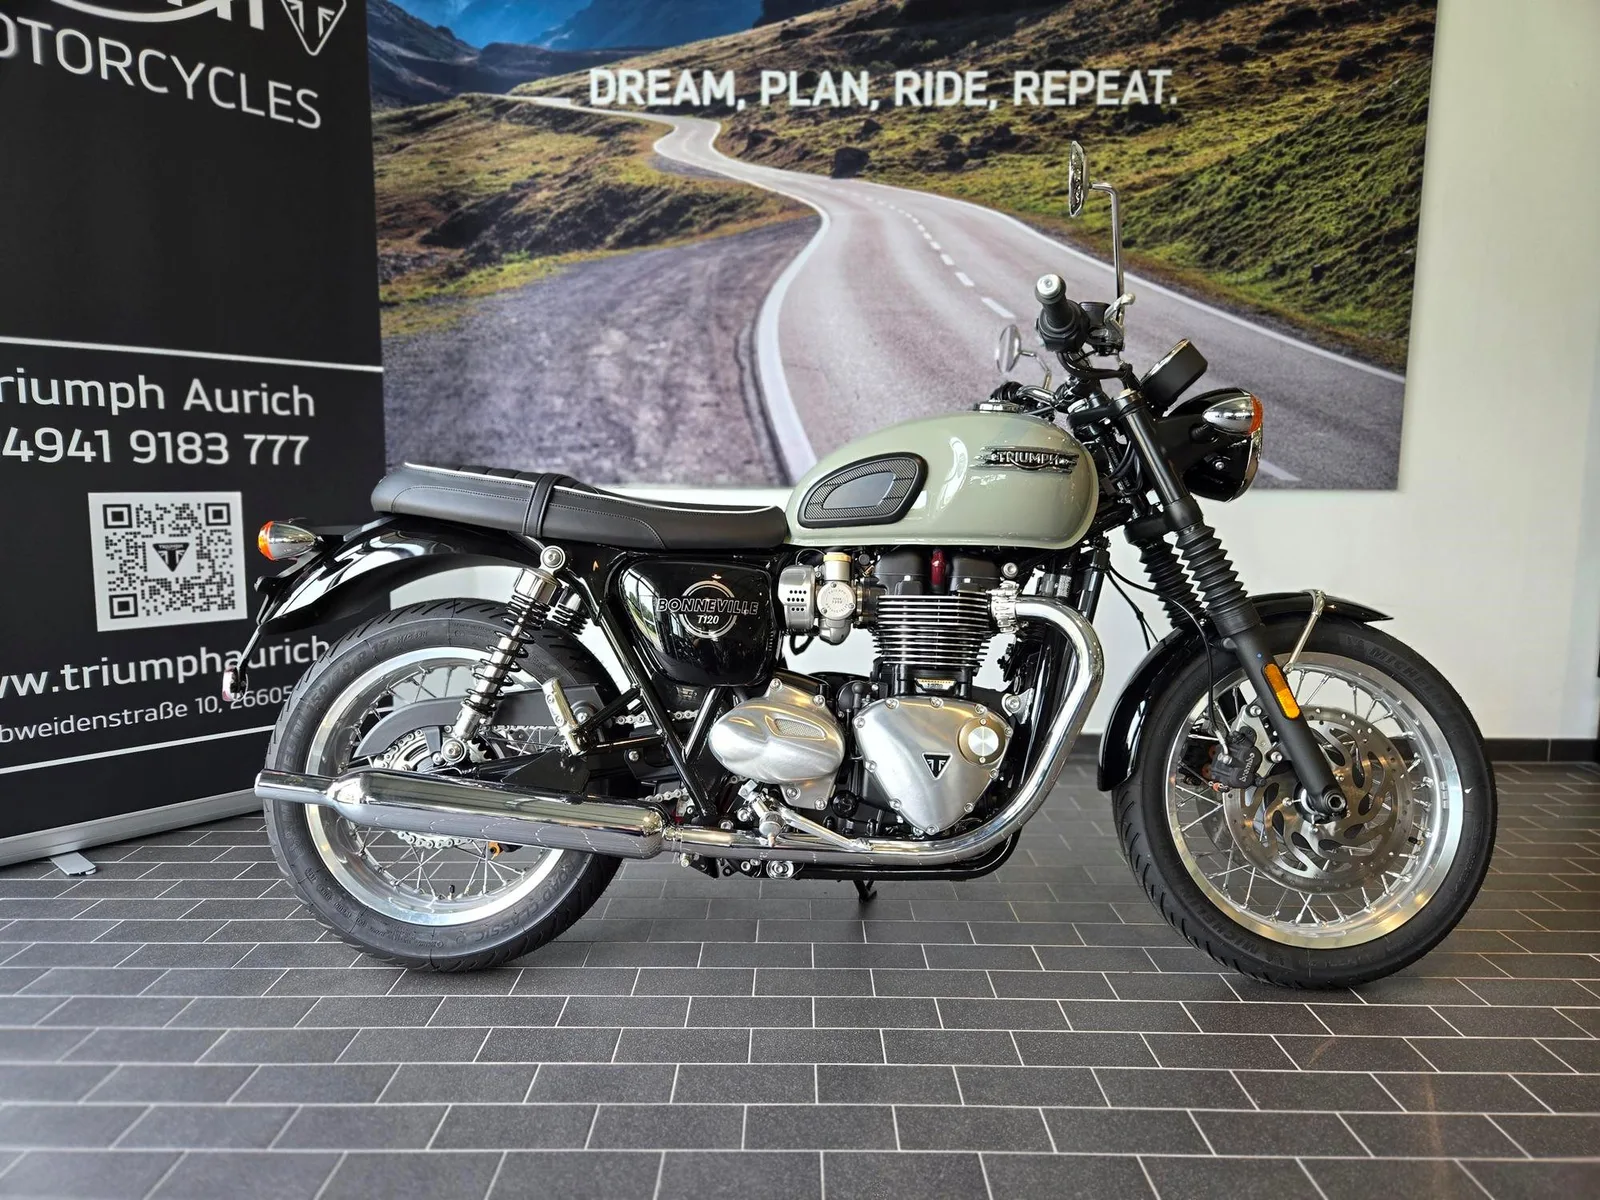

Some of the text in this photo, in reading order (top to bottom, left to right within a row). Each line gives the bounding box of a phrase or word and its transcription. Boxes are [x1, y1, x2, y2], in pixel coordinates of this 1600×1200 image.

[590, 69, 1178, 111] DREAM, PLAN, RIDE, REPEAT.
[0, 367, 315, 416] riumph Aurich
[2, 427, 309, 465] 4941 9183 777
[999, 451, 1060, 465] TRIUMPH
[657, 598, 759, 615] BONNEVILLE
[697, 614, 720, 625] T120
[0, 635, 330, 699] w.triumphaurich
[0, 700, 188, 743] bweidenstraße
[195, 696, 223, 714] 10,
[1239, 752, 1256, 782] brembo
